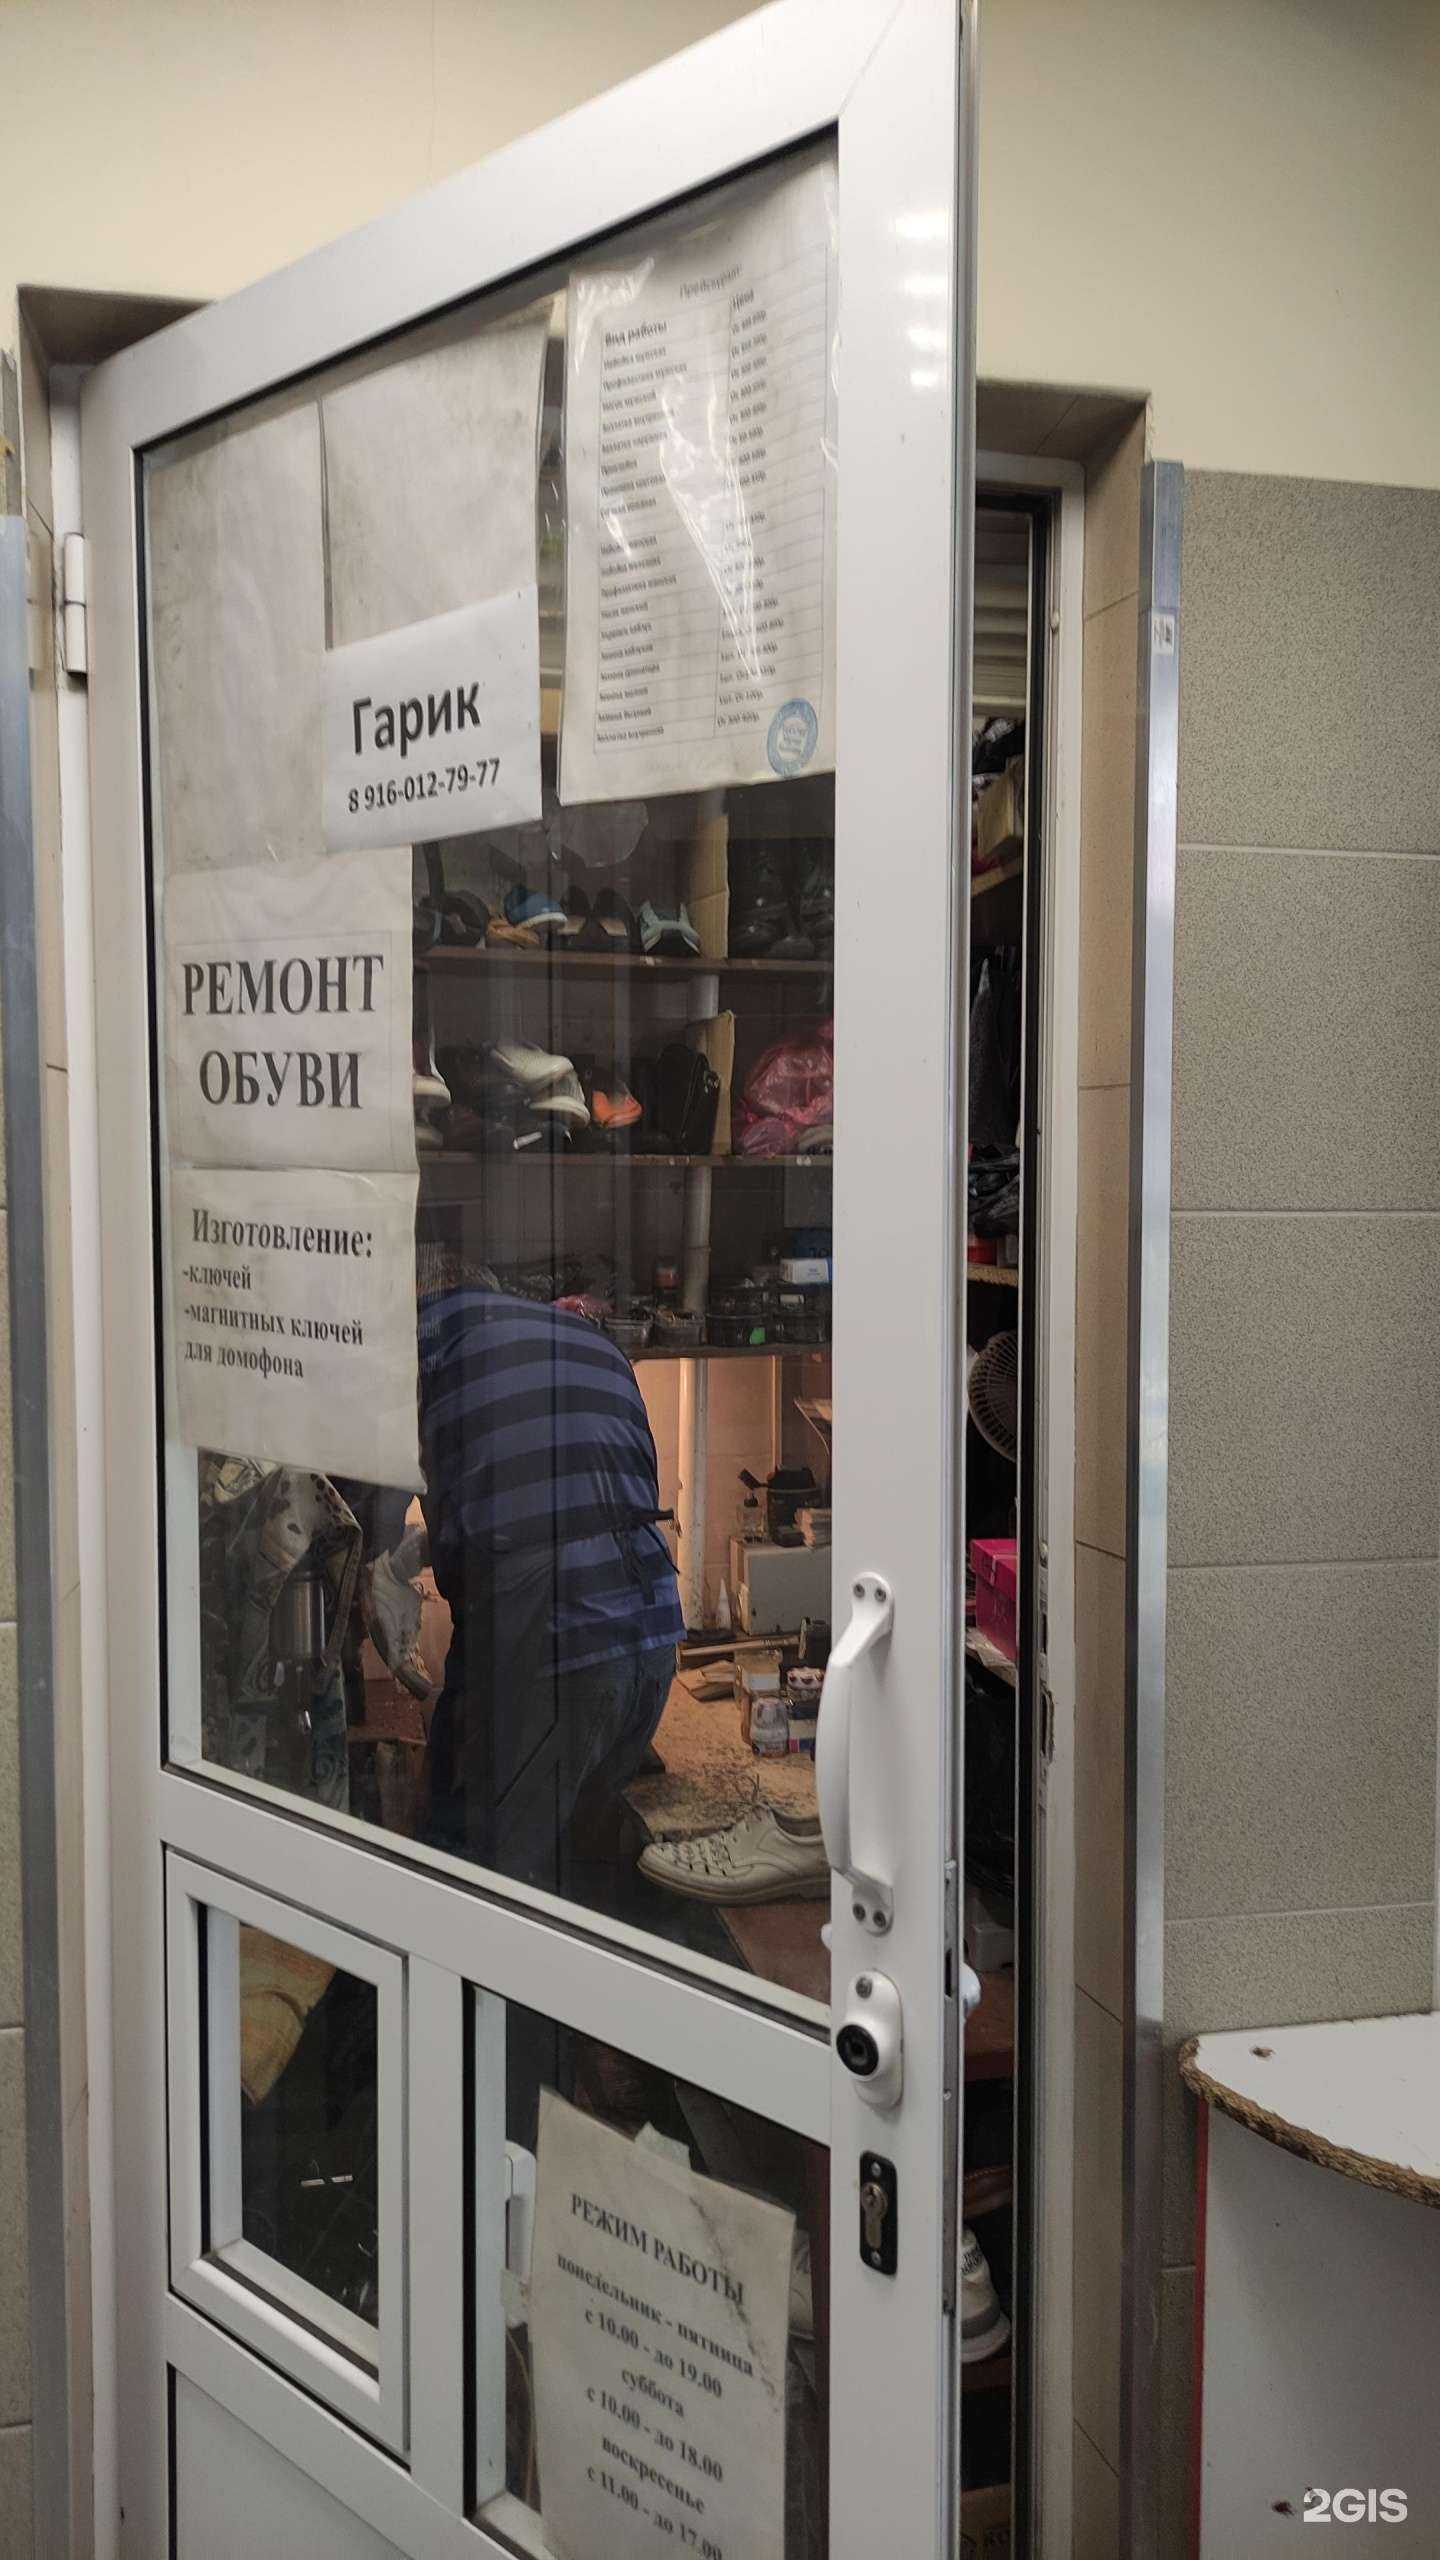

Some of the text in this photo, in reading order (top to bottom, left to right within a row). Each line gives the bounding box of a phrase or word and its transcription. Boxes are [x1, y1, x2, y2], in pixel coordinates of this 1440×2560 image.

[352, 681, 481, 759] Гарик
[348, 757, 500, 814] 8 916-012-79-77
[182, 953, 385, 1016] РЕМОНТ
[199, 1050, 363, 1109] ОБУВИ
[192, 1208, 373, 1259] Изготовление:
[182, 1264, 252, 1290] -ключей
[184, 1303, 364, 1346] -магнитных ключей
[185, 1341, 304, 1379] для домофона
[572, 2192, 743, 2303] РЕЖИМ РАБОТЫ
[557, 2252, 662, 2326] понедельник
[677, 2321, 753, 2377] пятница
[585, 2307, 593, 2326] с
[599, 2310, 639, 2351] 10.00
[654, 2350, 673, 2370] до
[679, 2356, 722, 2399] 19.00
[621, 2368, 685, 2418] суббота
[587, 2385, 595, 2402] с
[601, 2389, 641, 2430] 10.00
[654, 2431, 674, 2452] до
[679, 2440, 723, 2483] 18.00
[587, 2464, 595, 2482] с
[601, 2470, 639, 2511] 11.00
[653, 2512, 673, 2535] до
[602, 2436, 705, 2515] воскресенье
